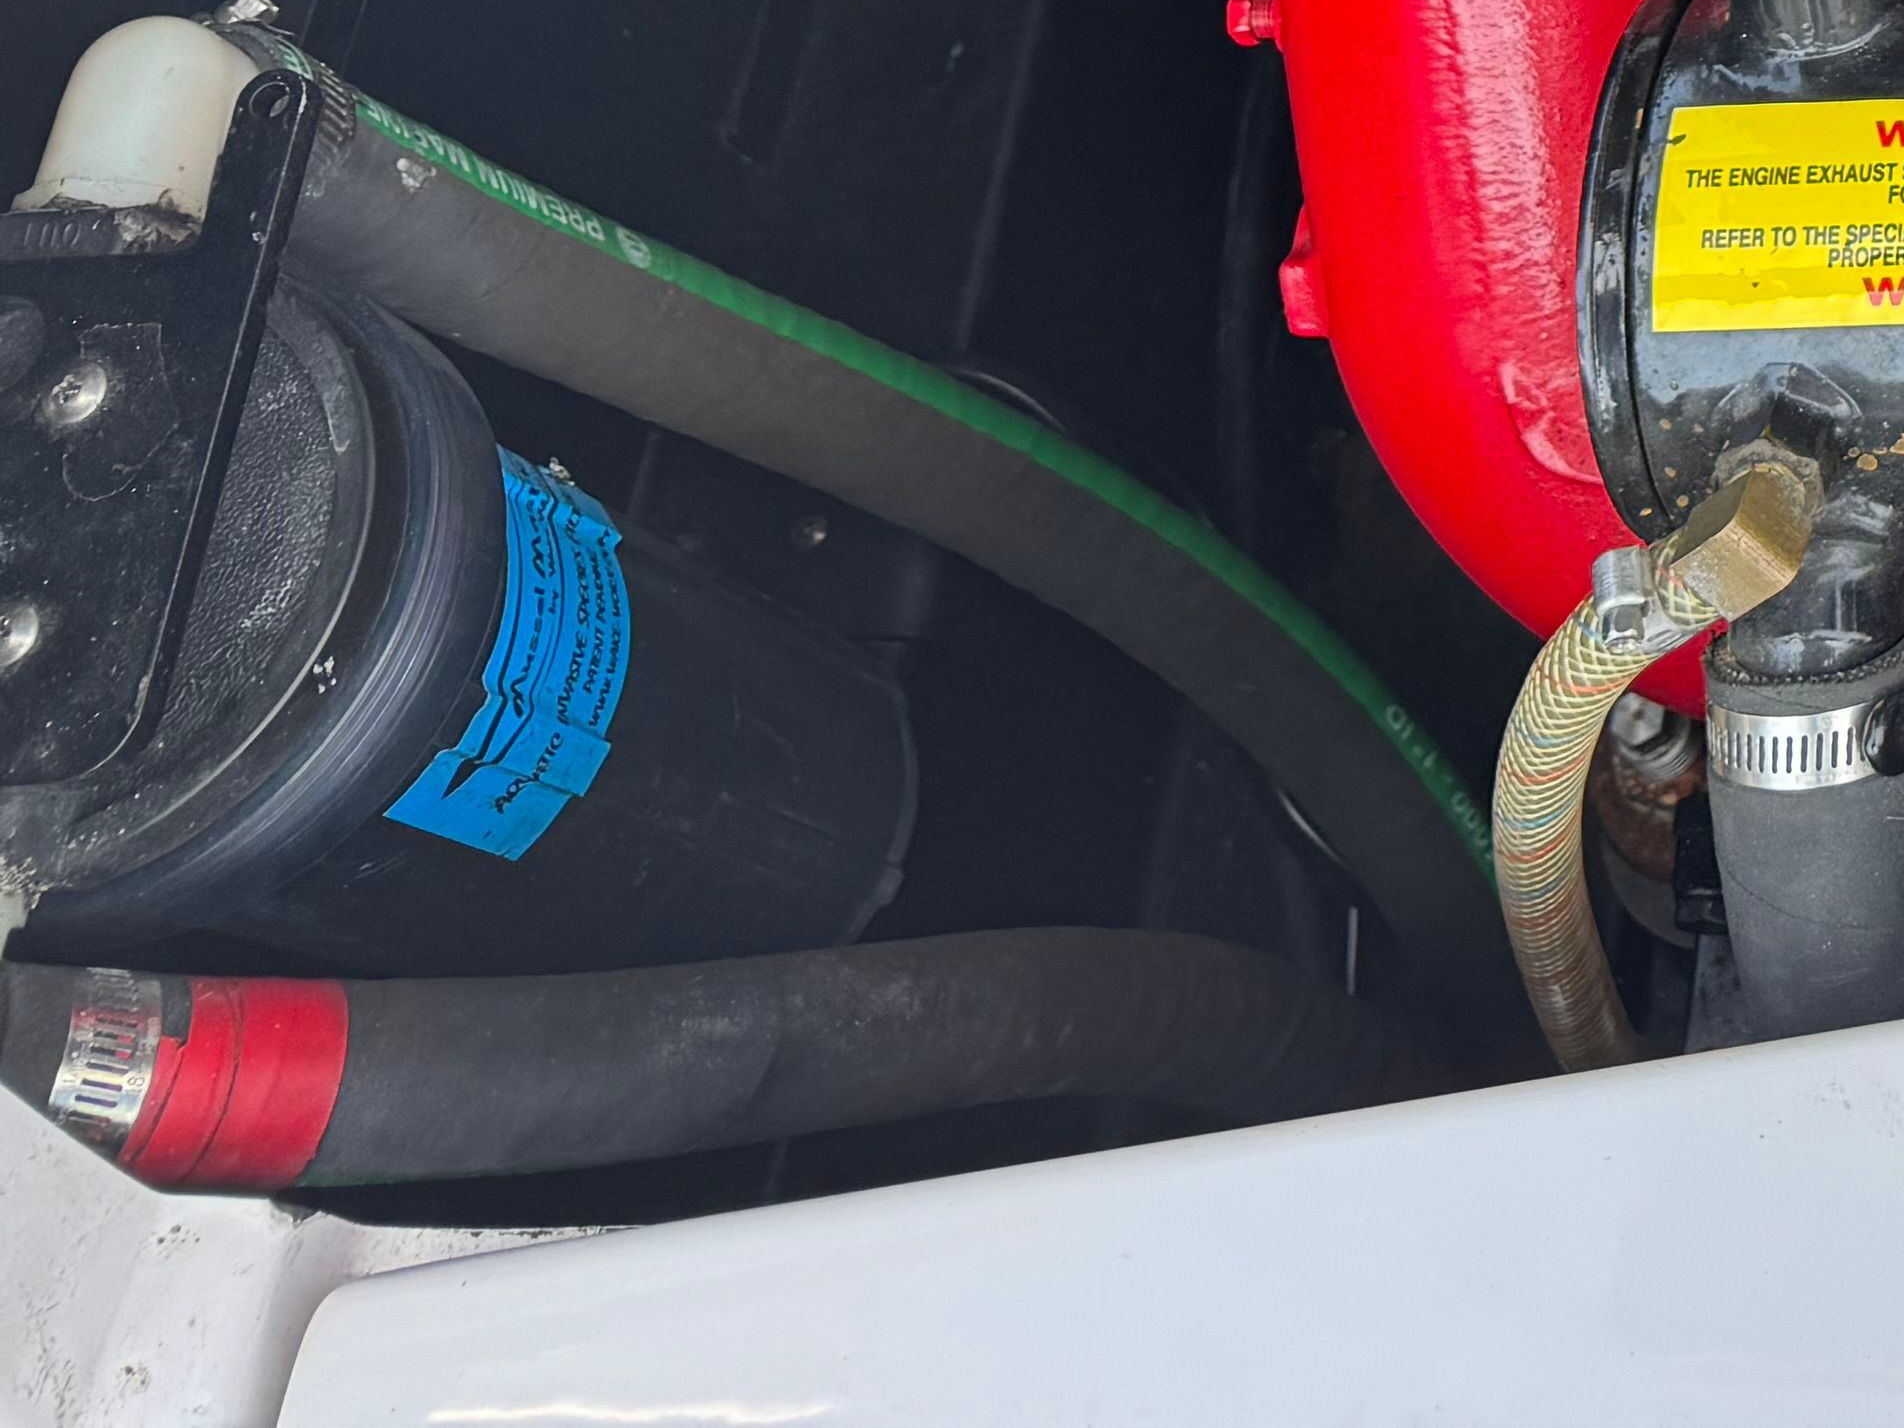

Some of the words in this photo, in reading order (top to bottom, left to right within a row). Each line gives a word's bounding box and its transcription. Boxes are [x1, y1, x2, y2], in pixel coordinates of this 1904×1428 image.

[1686, 168, 1723, 188] THE
[1728, 165, 1801, 186] ENGINE
[1806, 162, 1898, 184] EXHAUST
[1701, 228, 1765, 249] REFER
[1771, 226, 1797, 247] TO
[1803, 225, 1841, 245] THE
[556, 632, 588, 724] INVASIVE
